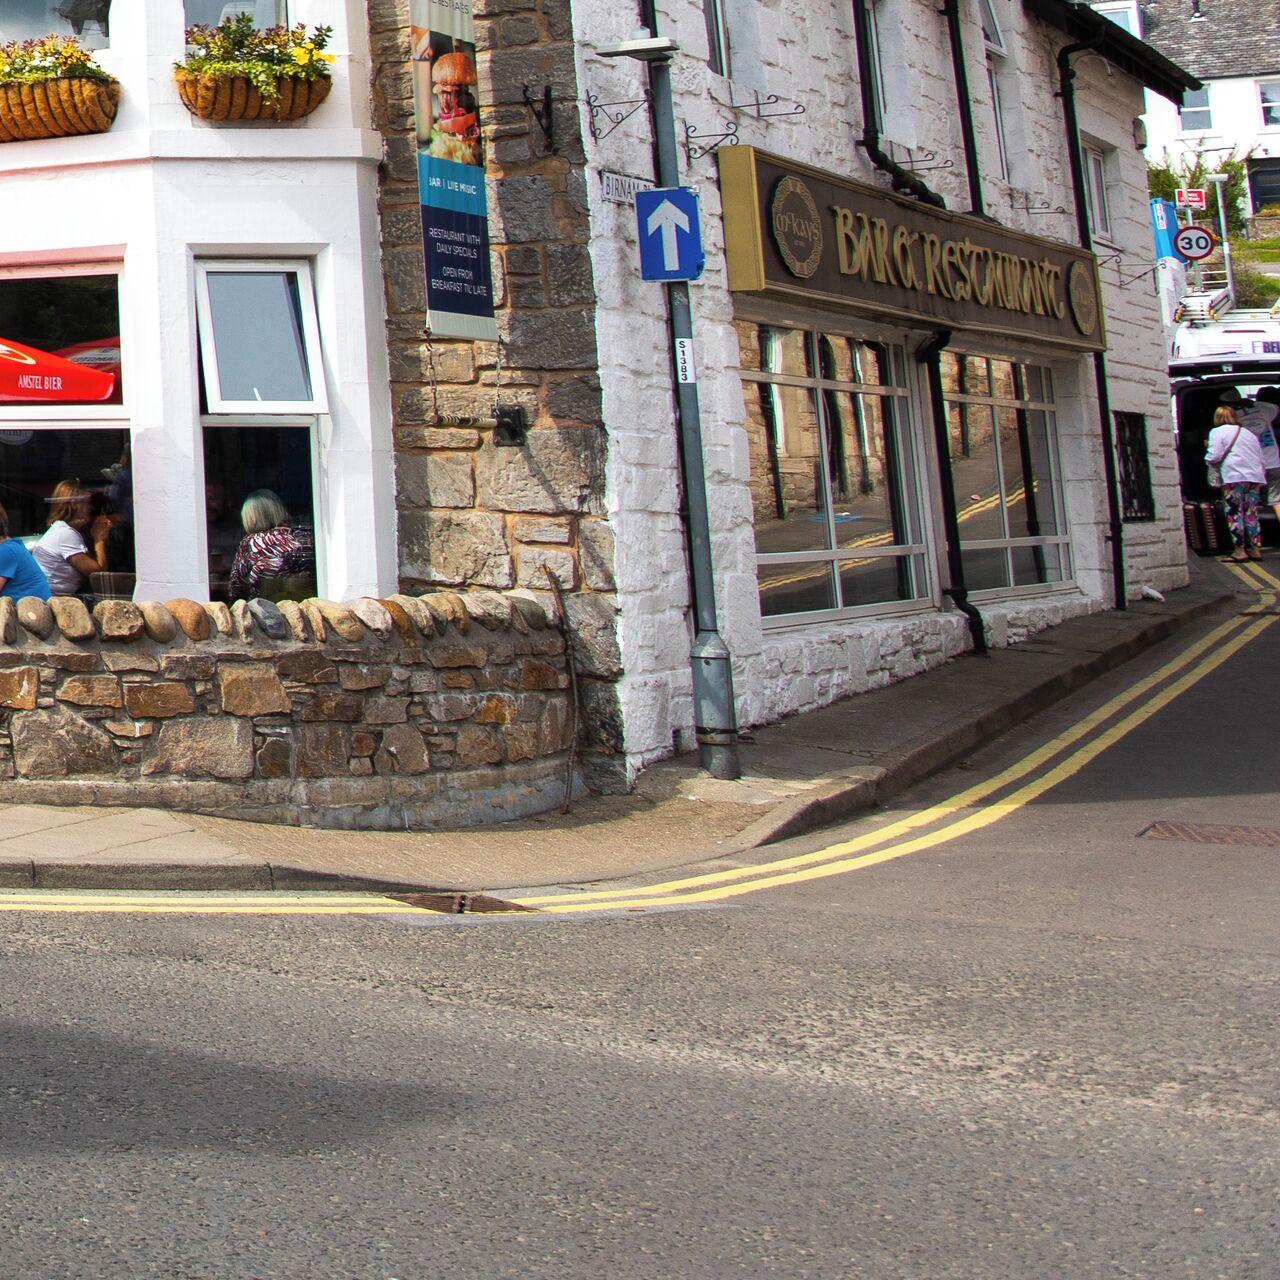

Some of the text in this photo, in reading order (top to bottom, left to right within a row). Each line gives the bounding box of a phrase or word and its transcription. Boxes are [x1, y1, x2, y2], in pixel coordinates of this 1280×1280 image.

[831, 205, 897, 286] BAR
[1180, 236, 1210, 250] 30
[679, 340, 688, 381] S1383
[18, 374, 64, 391] AMSTEL BIER
